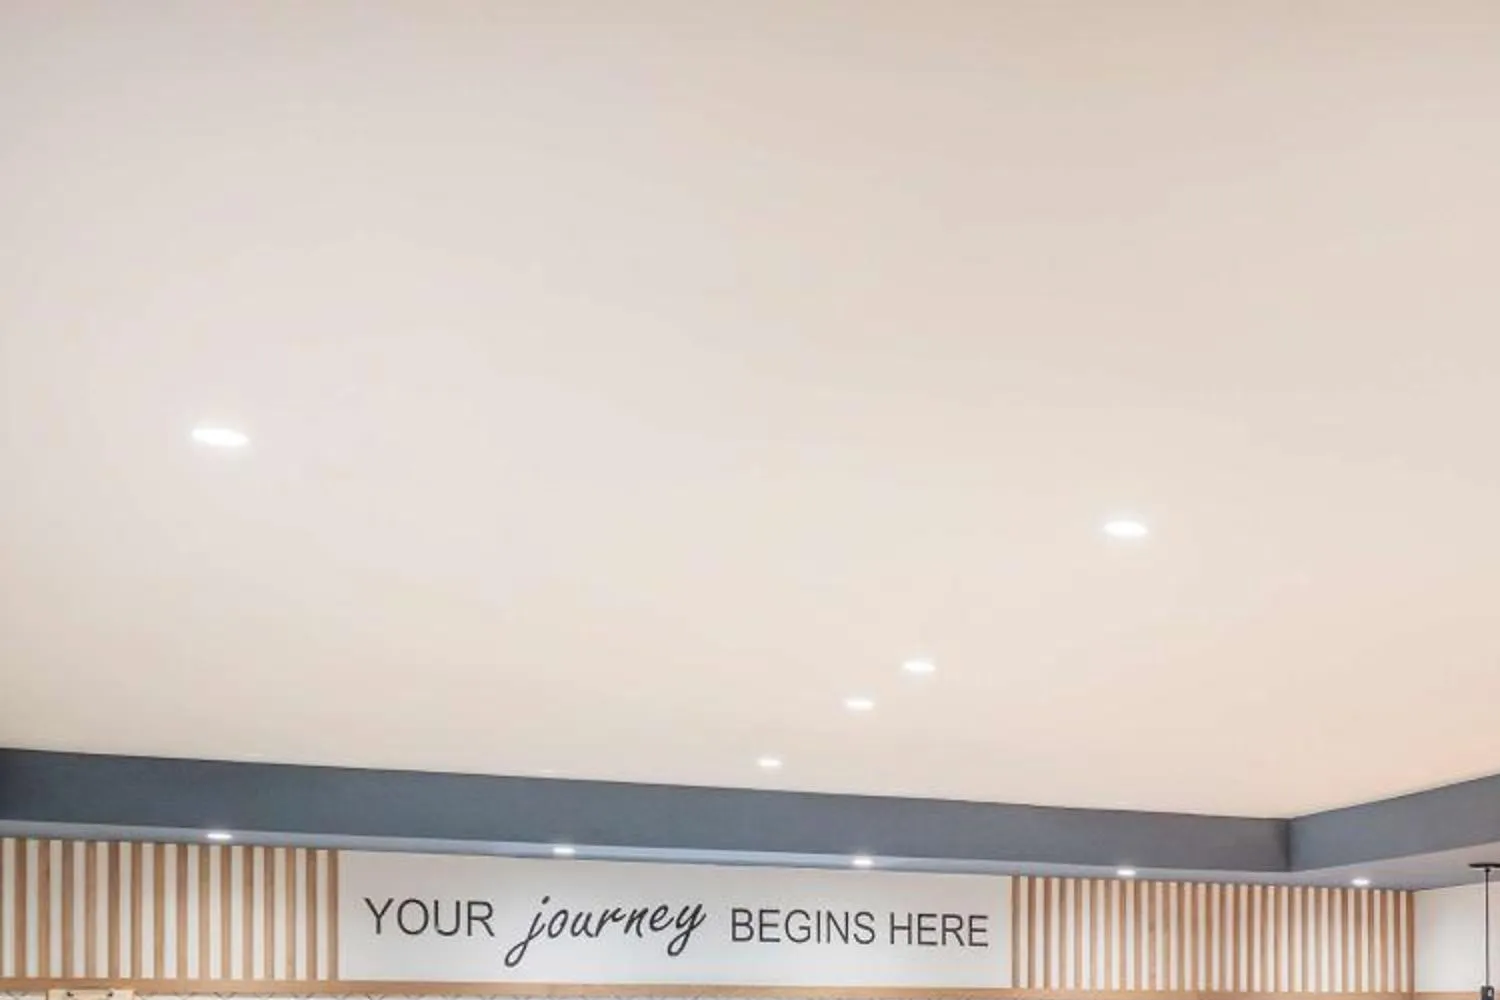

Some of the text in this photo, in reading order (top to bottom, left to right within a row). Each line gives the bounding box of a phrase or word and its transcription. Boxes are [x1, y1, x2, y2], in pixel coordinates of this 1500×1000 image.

[364, 895, 989, 967] YOUR journey BEGINS HERE
